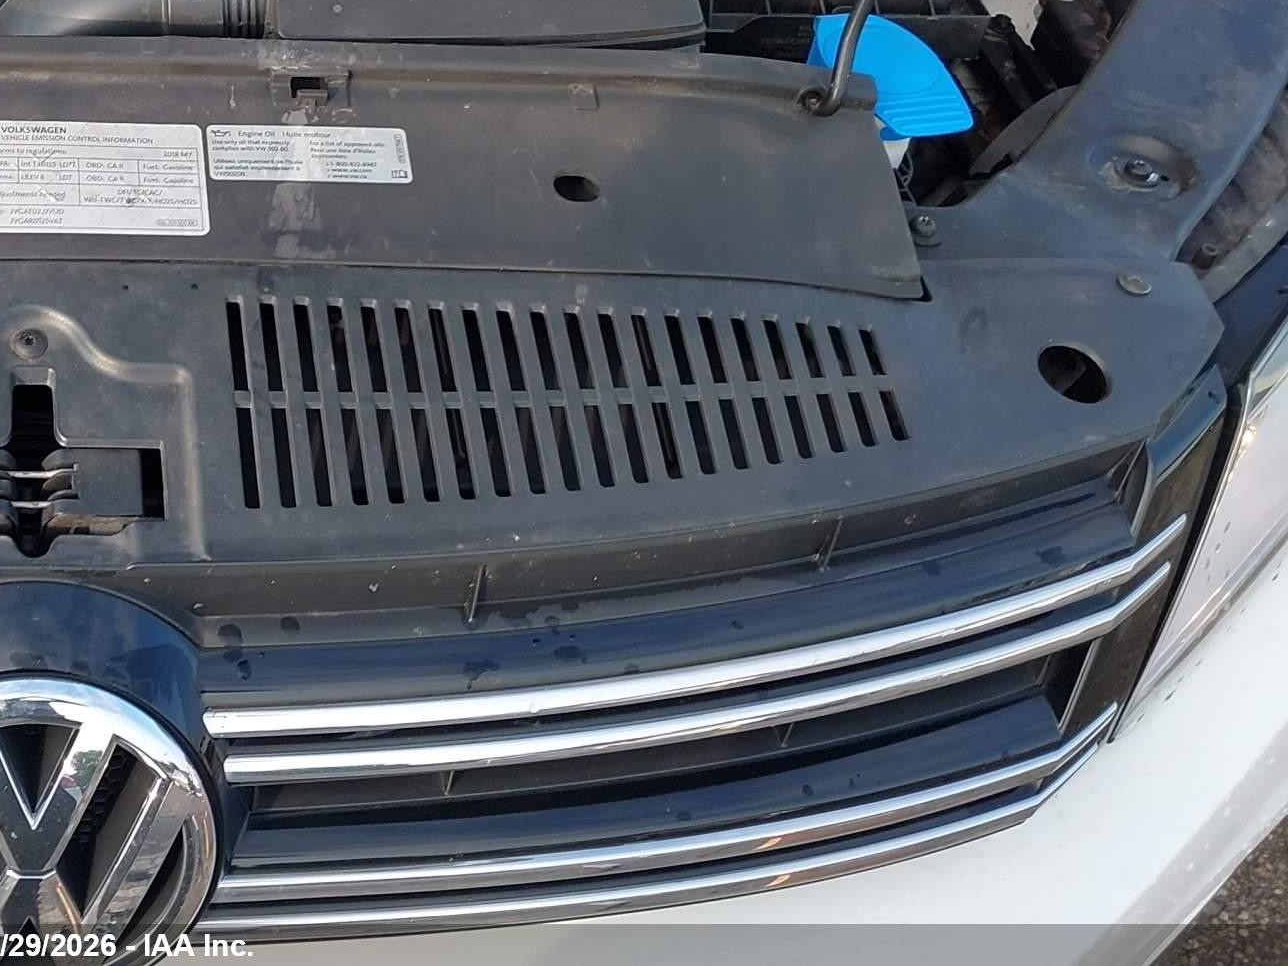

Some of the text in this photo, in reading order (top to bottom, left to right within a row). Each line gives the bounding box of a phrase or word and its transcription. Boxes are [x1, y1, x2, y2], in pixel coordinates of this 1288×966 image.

[1, 126, 67, 134] VOLKSWAGEN
[238, 130, 263, 138] Engine
[102, 136, 154, 144] INFORMATION
